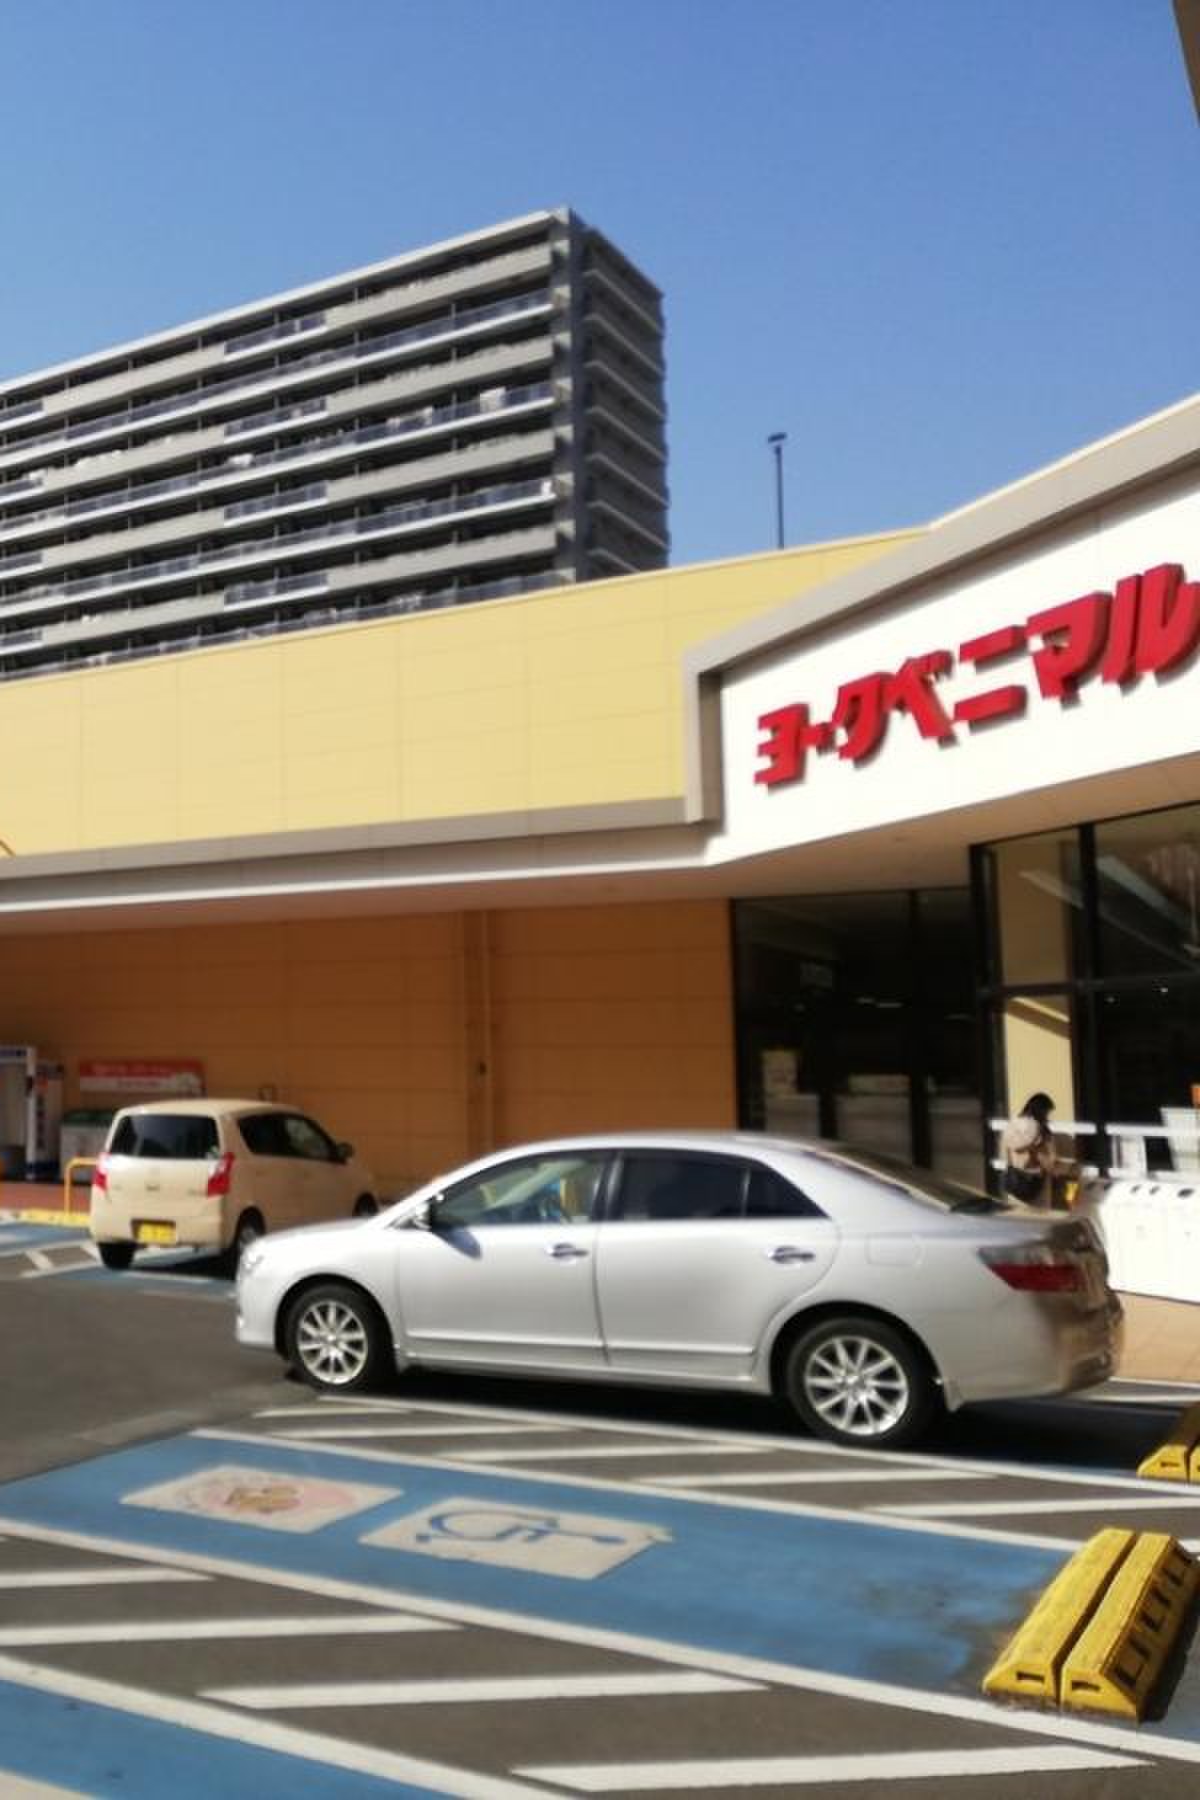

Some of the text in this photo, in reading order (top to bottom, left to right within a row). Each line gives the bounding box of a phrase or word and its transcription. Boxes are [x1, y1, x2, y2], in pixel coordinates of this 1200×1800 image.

[754, 563, 1200, 788] ヨークベニマル
